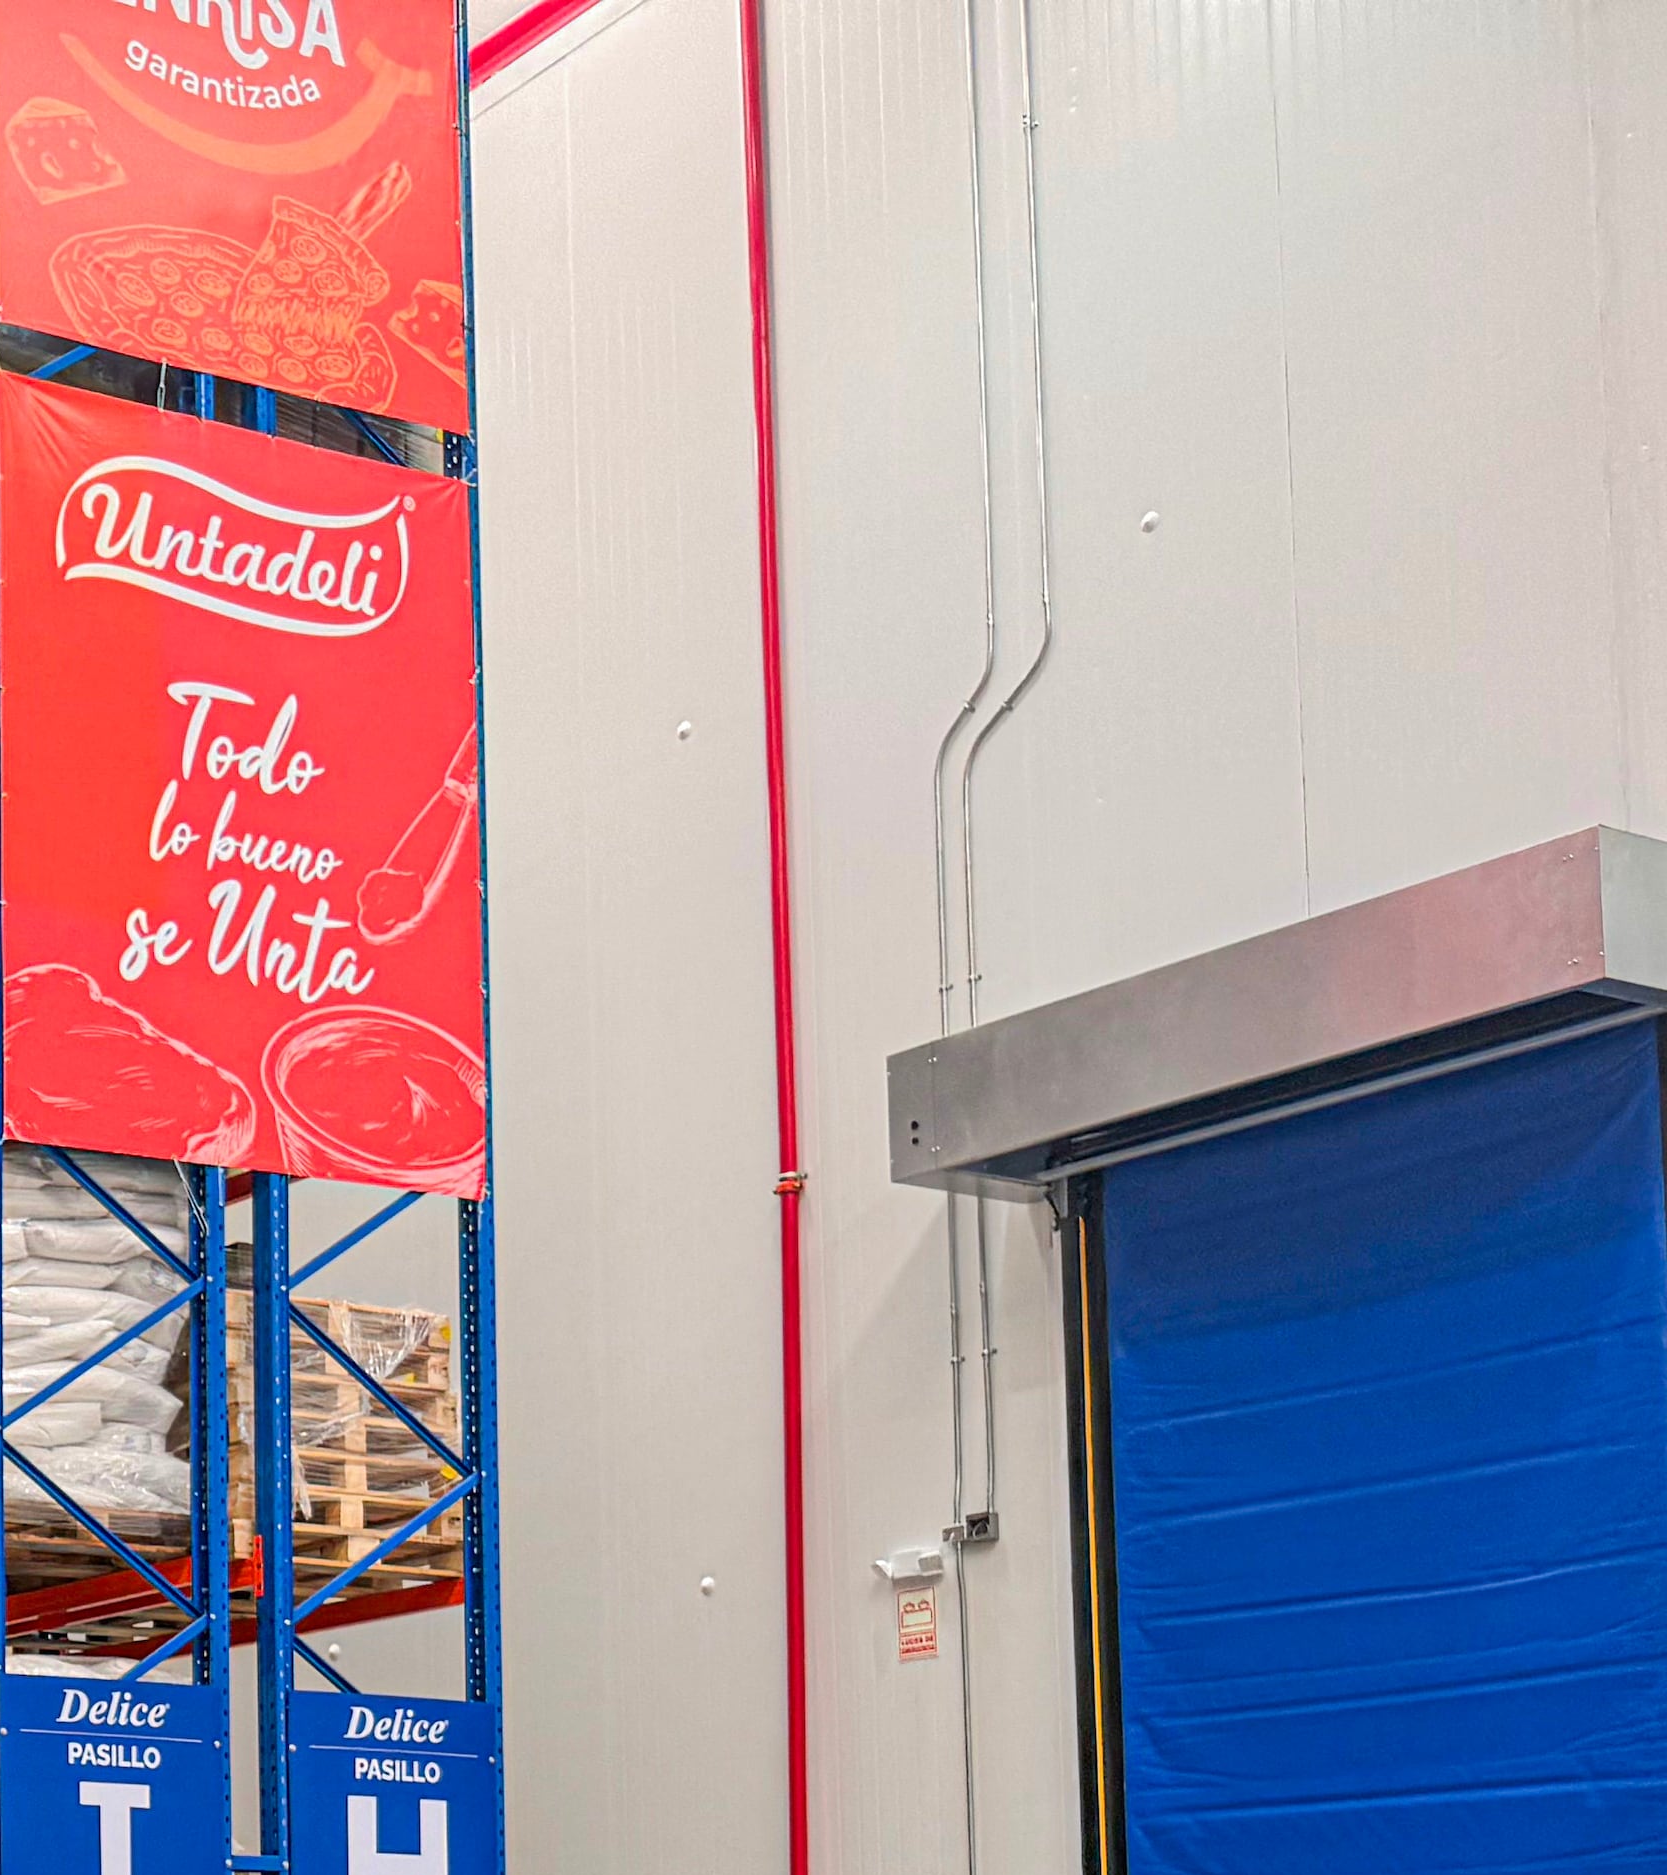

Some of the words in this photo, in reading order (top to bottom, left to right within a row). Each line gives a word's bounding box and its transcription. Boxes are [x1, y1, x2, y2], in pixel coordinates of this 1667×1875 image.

[124, 40, 322, 109] garantizada
[81, 483, 385, 616] Untadeli
[167, 681, 325, 795] Todo
[149, 779, 201, 862] lo
[207, 790, 343, 884] bueno
[119, 908, 194, 982] se
[207, 879, 376, 1004] Unta
[56, 1688, 170, 1729] Delice
[343, 1705, 449, 1744] Delice
[67, 1742, 162, 1769] PASILLO
[354, 1756, 442, 1784] PASILLO
